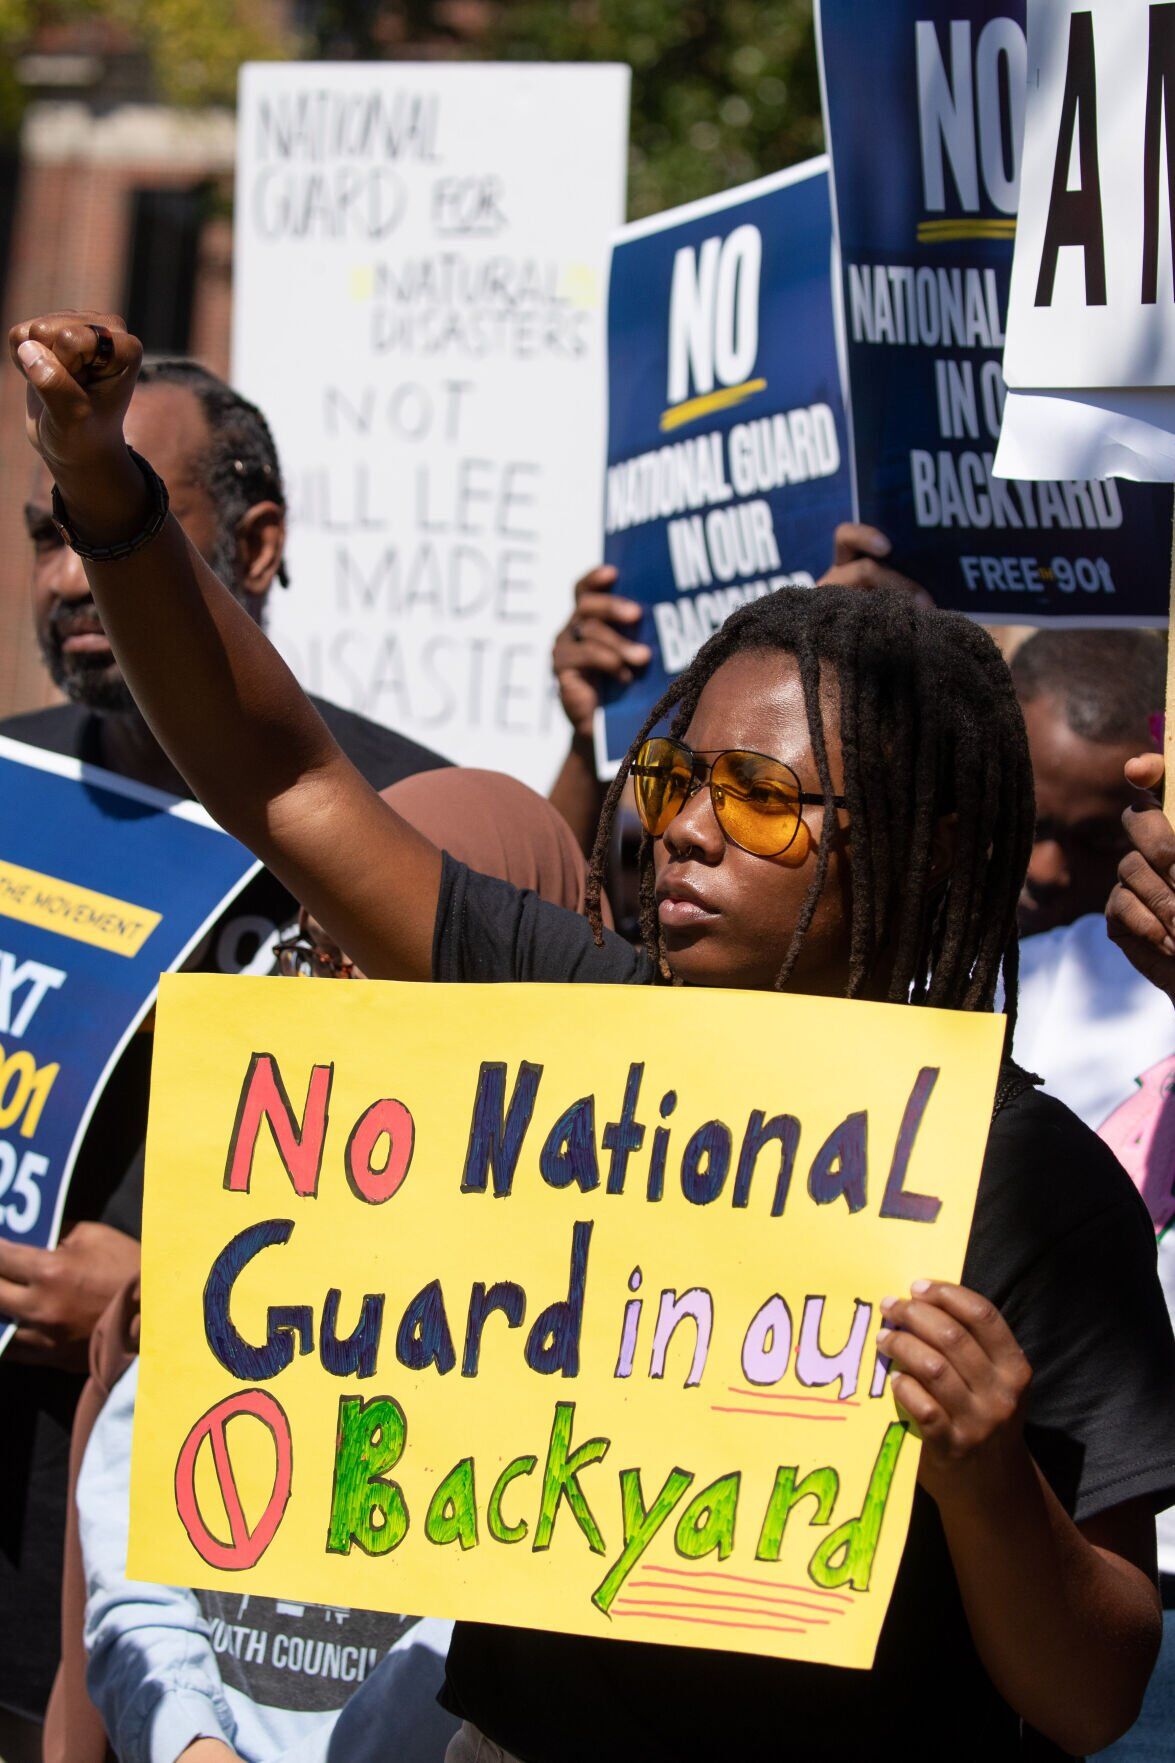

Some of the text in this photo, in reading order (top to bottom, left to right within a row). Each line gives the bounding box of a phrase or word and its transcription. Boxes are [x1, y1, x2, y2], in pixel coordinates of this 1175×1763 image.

[254, 88, 442, 164] NATIONAL
[915, 16, 1027, 215] NO
[252, 166, 509, 242] GUARD FOR
[372, 252, 570, 307] NATURAL
[667, 223, 763, 405] NO
[848, 264, 1006, 348] NATIONAL
[370, 306, 590, 360] DISASTERS
[322, 378, 474, 442] NOT
[935, 359, 980, 440] IN
[414, 457, 542, 542] LEE
[605, 402, 842, 536] NATIONAL GUARD
[332, 541, 540, 624] MADE
[666, 498, 782, 592] IN OUR
[959, 555, 1045, 593] FREE
[0, 1043, 60, 1139] 01
[222, 1051, 416, 1206] No
[202, 1218, 594, 1382] Guard
[613, 1265, 715, 1389] in
[325, 1394, 910, 1622] Backyard
